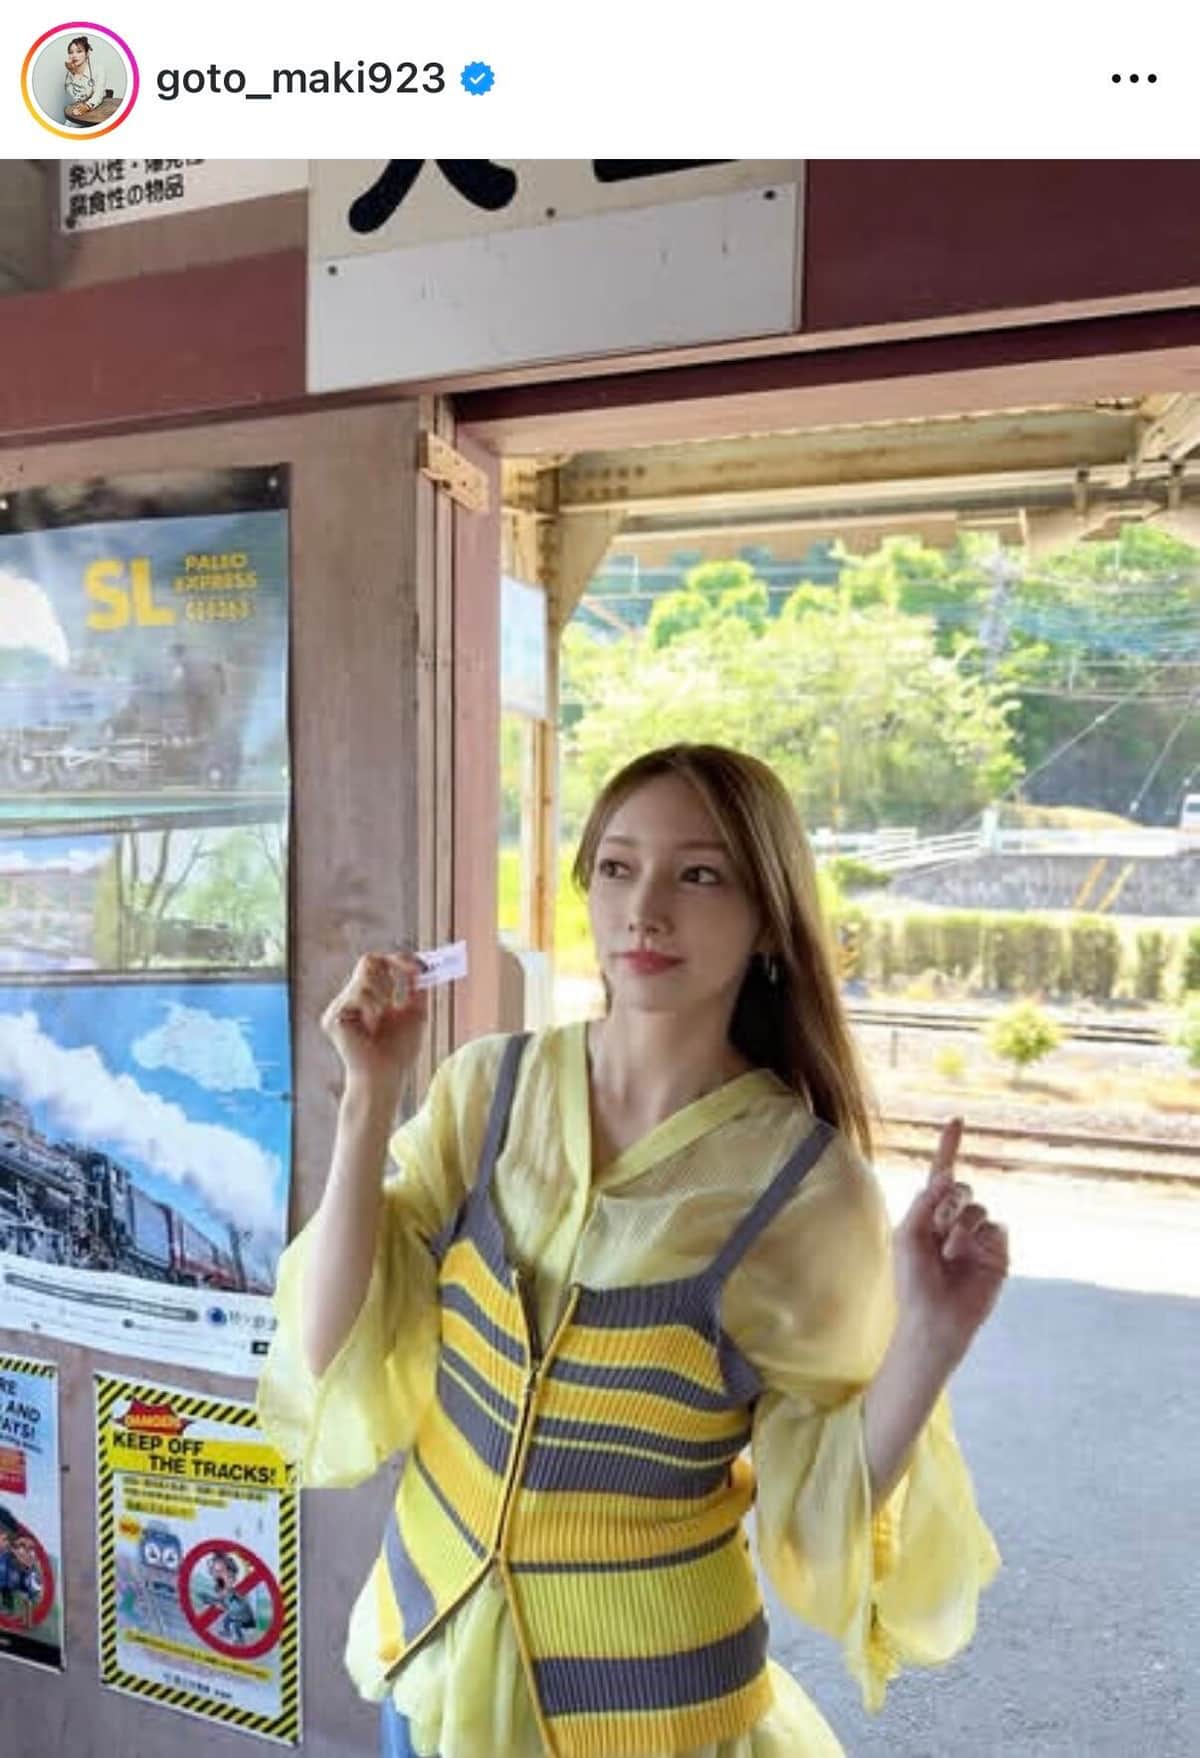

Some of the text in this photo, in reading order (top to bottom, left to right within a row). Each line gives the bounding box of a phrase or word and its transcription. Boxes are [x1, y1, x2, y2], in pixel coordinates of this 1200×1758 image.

[84, 557, 177, 630] SL
[5, 1400, 42, 1423] AND
[112, 1430, 205, 1455] KEEP OFF
[149, 1455, 277, 1484] THE TRACKS!
